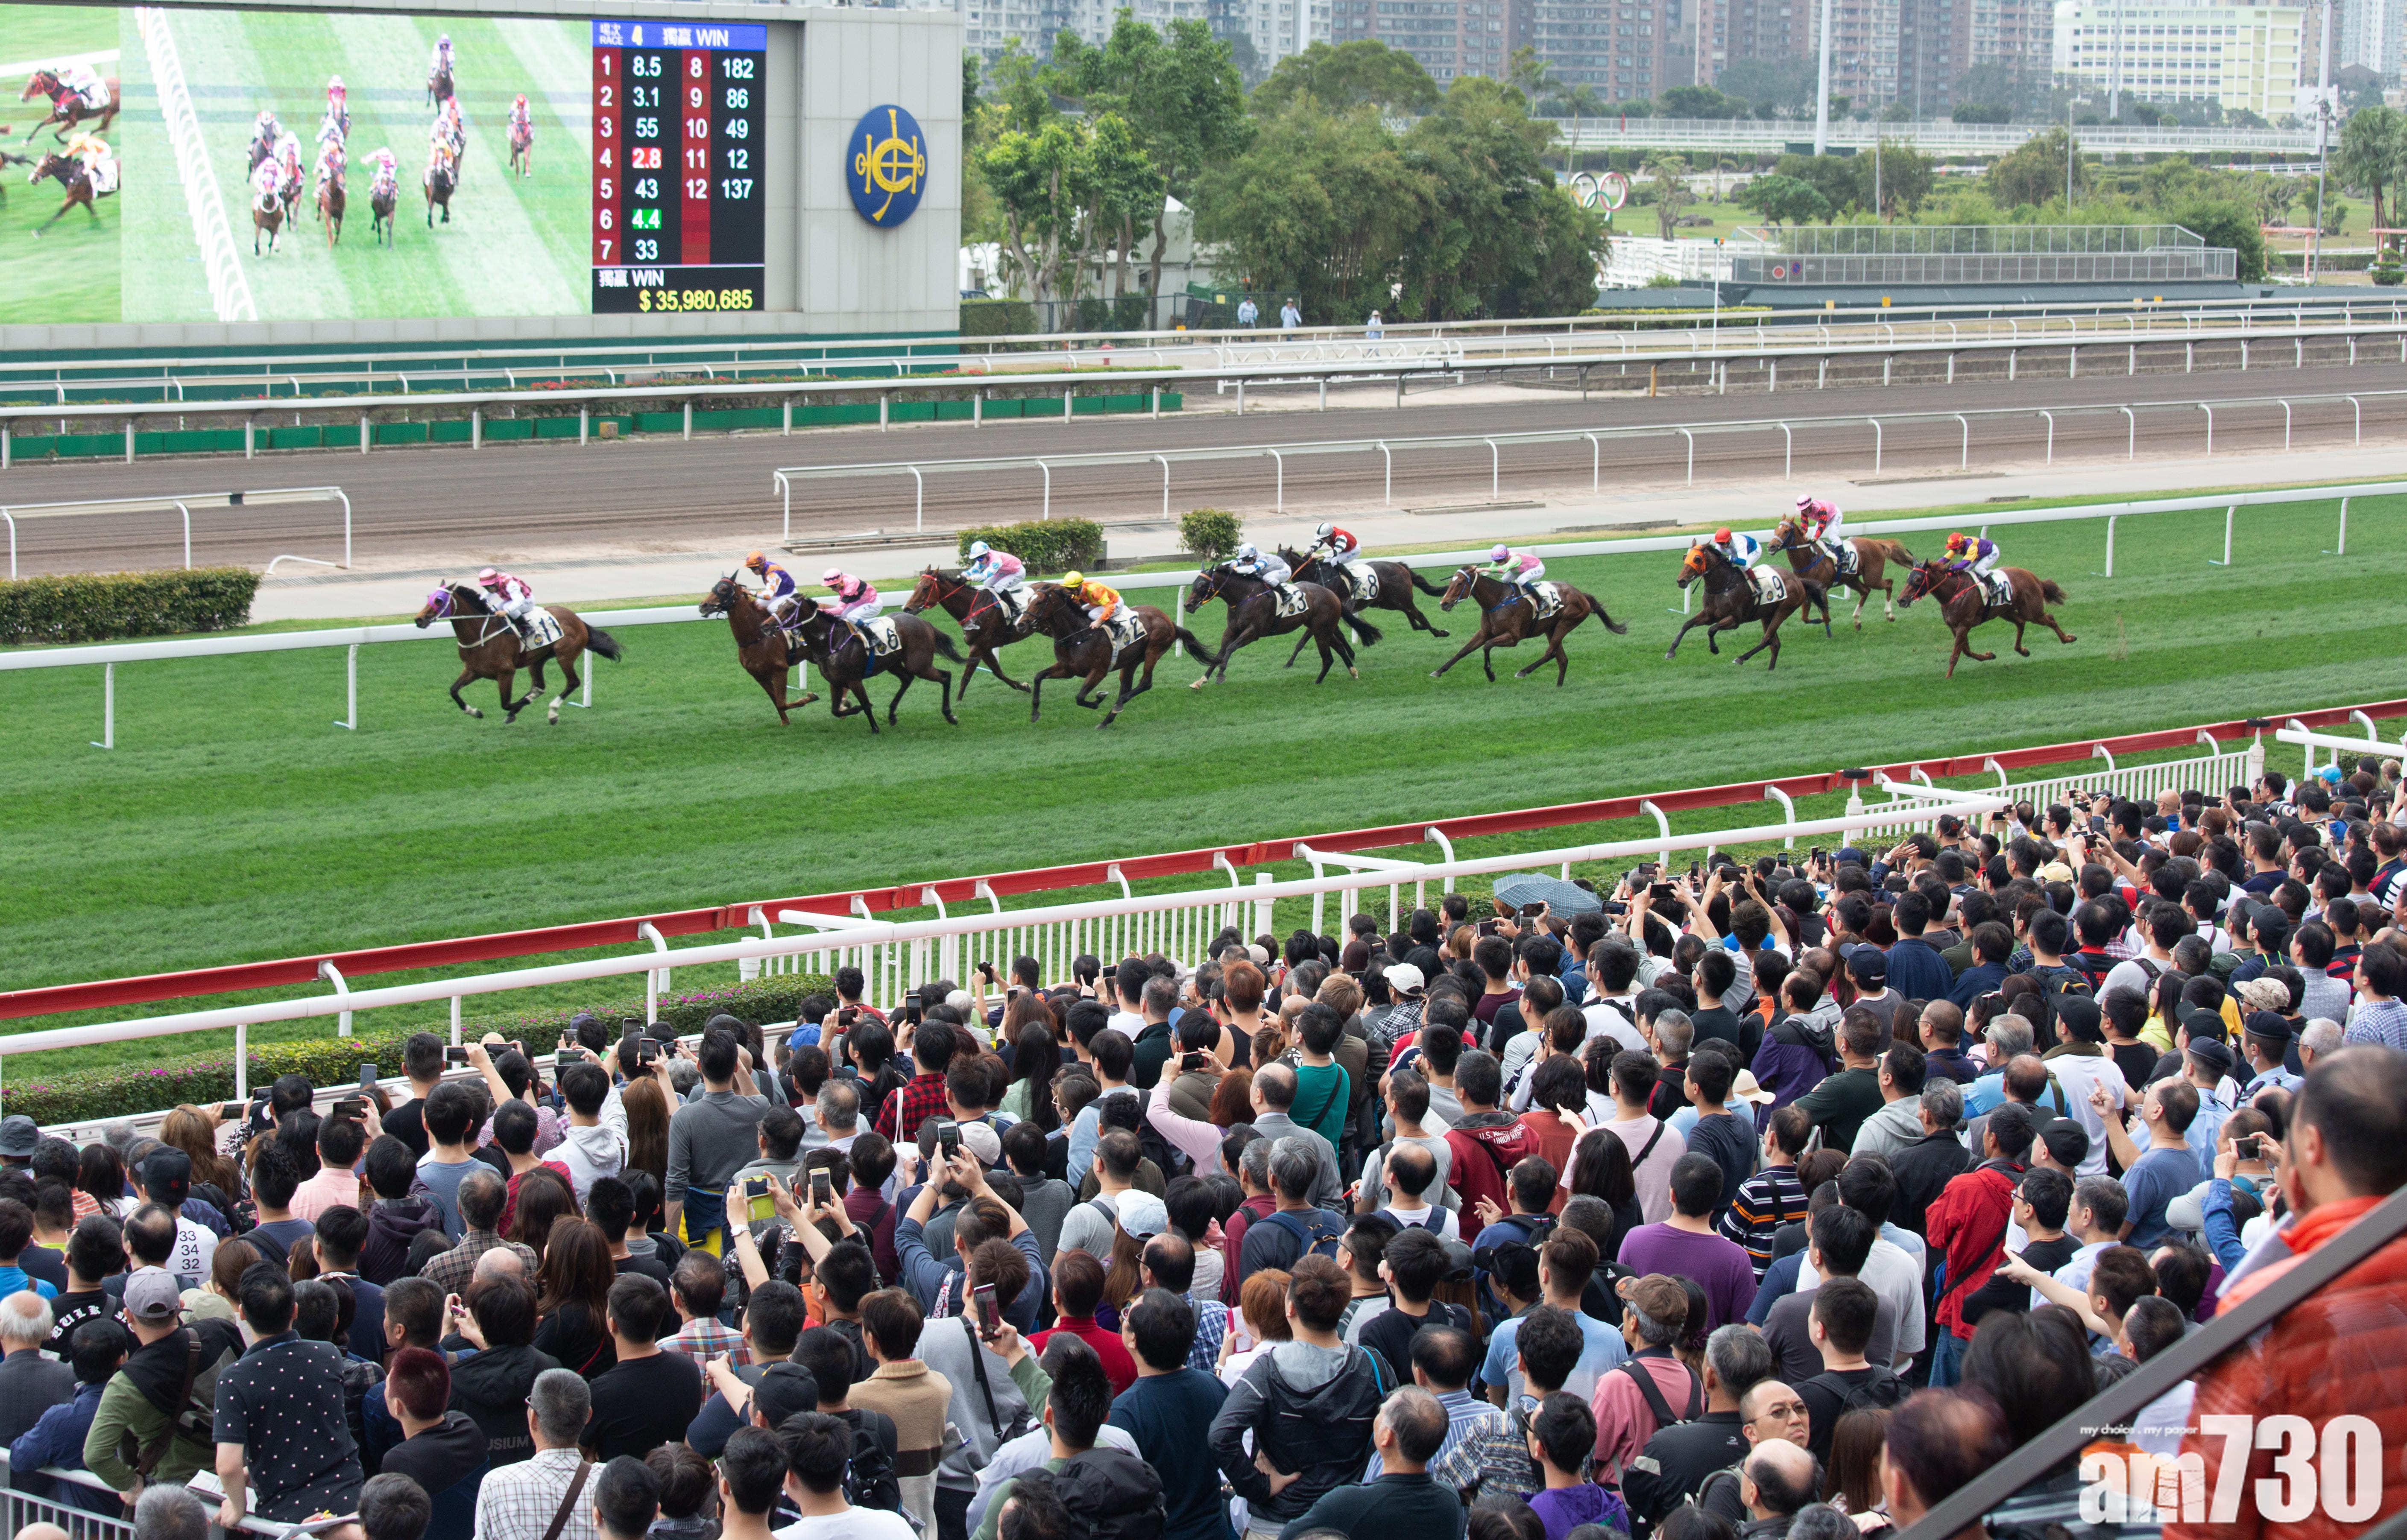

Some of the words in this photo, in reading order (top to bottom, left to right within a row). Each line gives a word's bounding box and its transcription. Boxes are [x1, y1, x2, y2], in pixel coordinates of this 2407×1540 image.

[599, 36, 623, 45] RACE
[632, 25, 643, 46] 4
[696, 28, 729, 47] WIN
[602, 55, 611, 76] 1
[633, 55, 662, 77] 8.5
[690, 56, 703, 78] 8
[723, 58, 754, 79] 182
[600, 85, 612, 106] 2
[633, 86, 659, 107] 3.1
[690, 87, 703, 108] 9
[726, 88, 749, 108] 86
[600, 117, 612, 137] 3
[636, 117, 659, 138] 55
[687, 118, 708, 139] 10
[725, 118, 749, 139] 49
[600, 147, 612, 168] 4
[632, 148, 661, 169] 2.8
[686, 148, 705, 169] 11
[727, 148, 748, 169] 12
[600, 178, 612, 199] 5
[635, 178, 659, 199] 43
[686, 178, 707, 199] 12
[721, 178, 753, 199] 137
[600, 208, 612, 230] 6
[632, 209, 660, 229] 4.4
[600, 240, 612, 260] 7
[635, 239, 658, 260] 33
[632, 269, 664, 287] WIN
[639, 289, 651, 313] $
[656, 289, 753, 313] 35,980,685
[1368, 575, 1378, 598] 8
[1772, 576, 1784, 599] 9
[1293, 590, 1306, 612] 3
[1549, 591, 1560, 611] 5
[539, 616, 562, 643] 11
[1130, 615, 1146, 640] 2
[887, 628, 899, 650] 6
[1479, 1131, 1493, 1140] U.S.
[1493, 1134, 1511, 1145] UNION
[179, 1230, 196, 1242] 33
[182, 1244, 199, 1256] 34
[182, 1258, 200, 1270] 32
[50, 1305, 102, 1340] BULK
